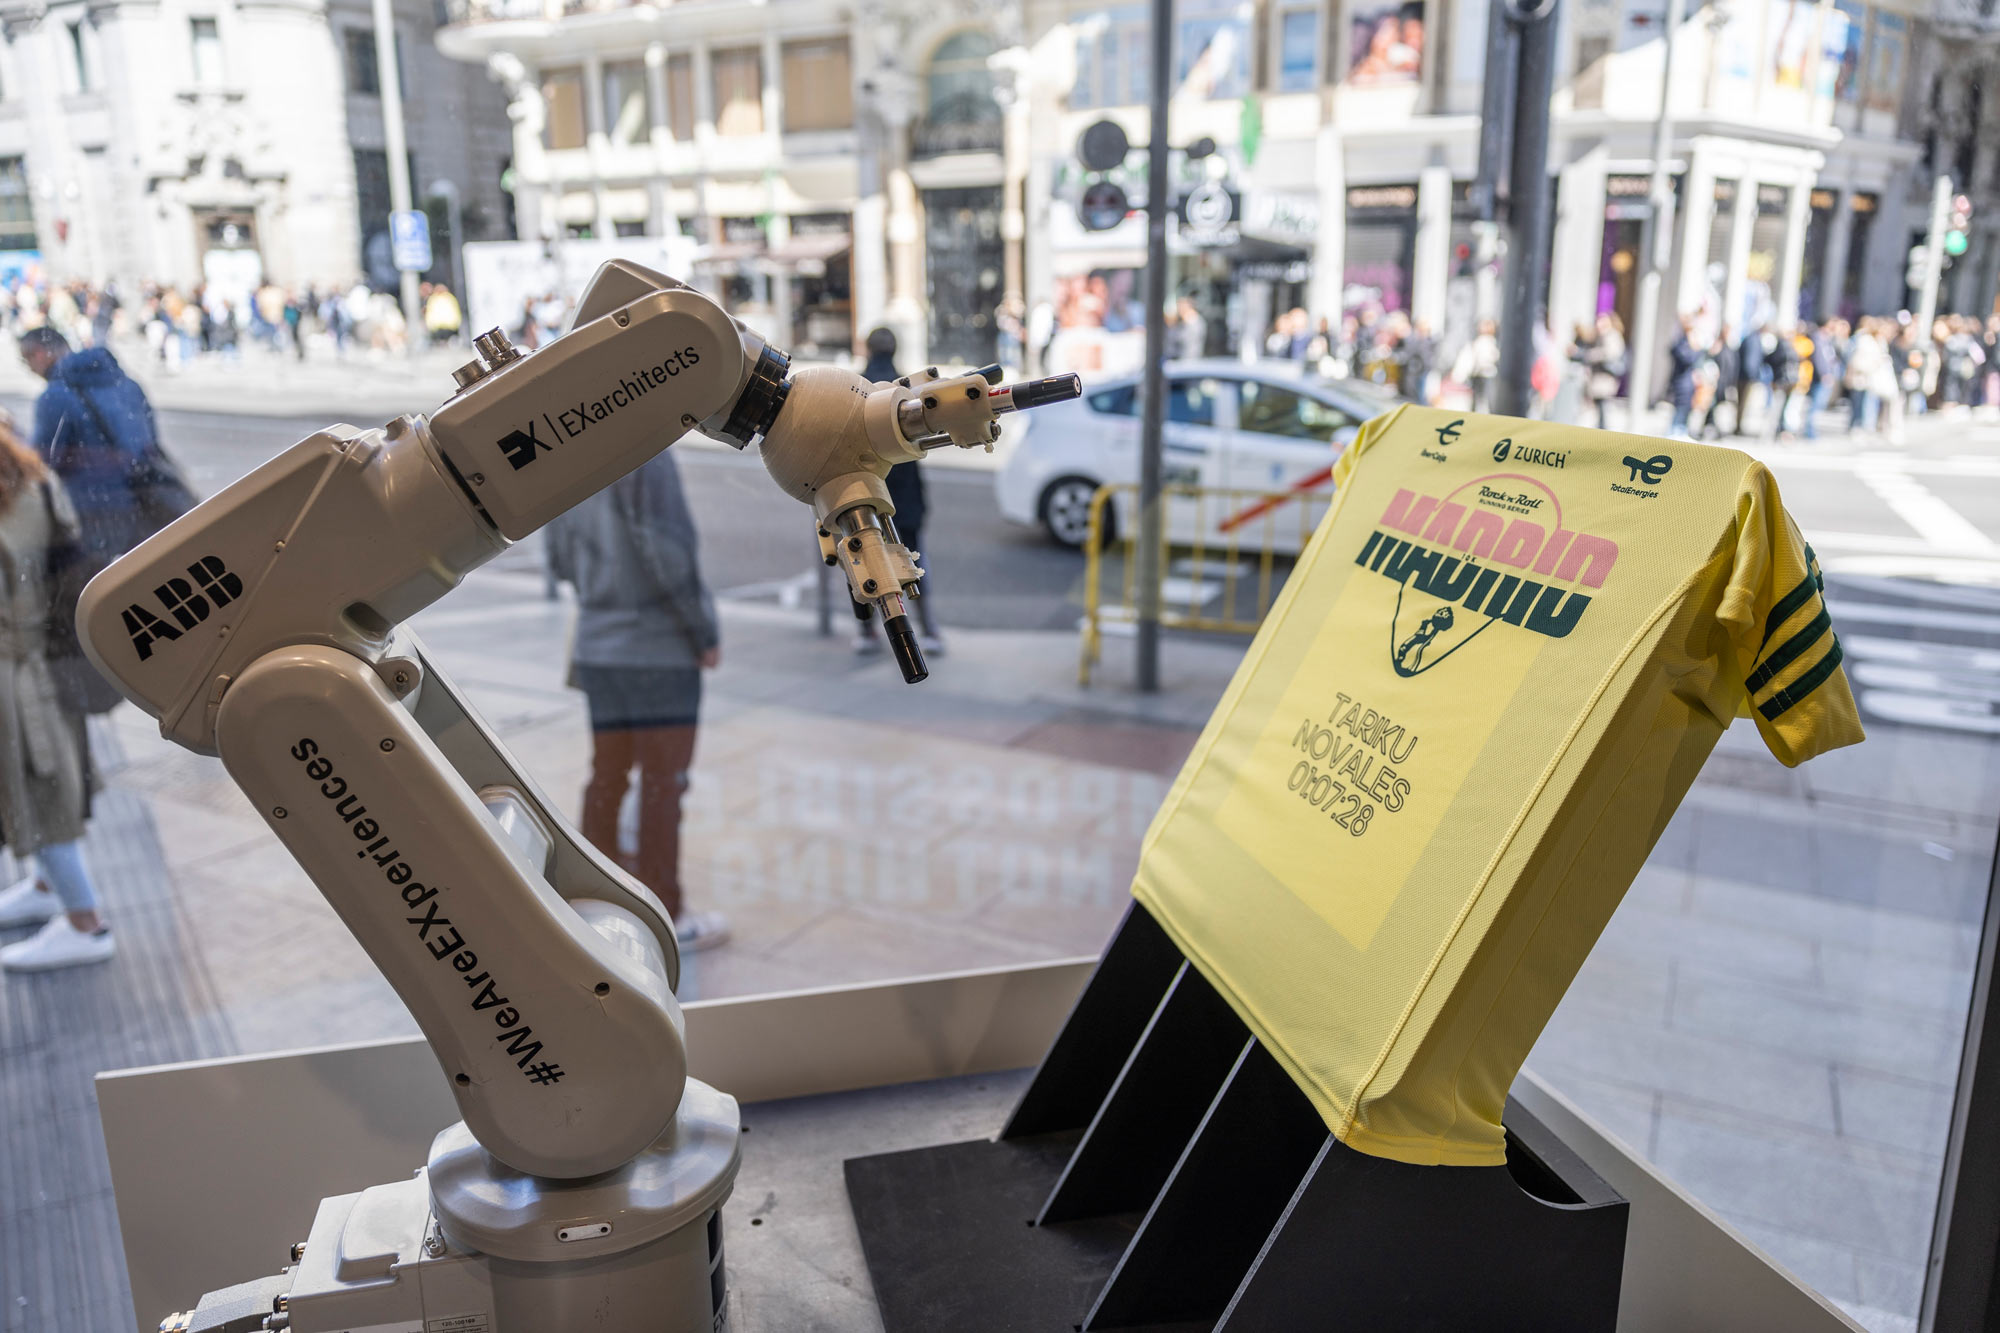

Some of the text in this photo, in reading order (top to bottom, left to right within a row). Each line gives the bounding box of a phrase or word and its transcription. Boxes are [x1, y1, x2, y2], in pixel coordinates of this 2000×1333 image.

[558, 345, 701, 438] EXarchitects
[1513, 445, 1567, 468] ZURICH
[1610, 483, 1659, 499] TotalEnergies
[1478, 498, 1530, 515] RUNNING SERIES
[121, 555, 244, 661] ABB
[1292, 718, 1411, 812] NOVALES
[1328, 691, 1418, 764] TARIKU
[1287, 760, 1374, 837] 01:07:28
[290, 737, 566, 1087] #WeAreEXperiences
